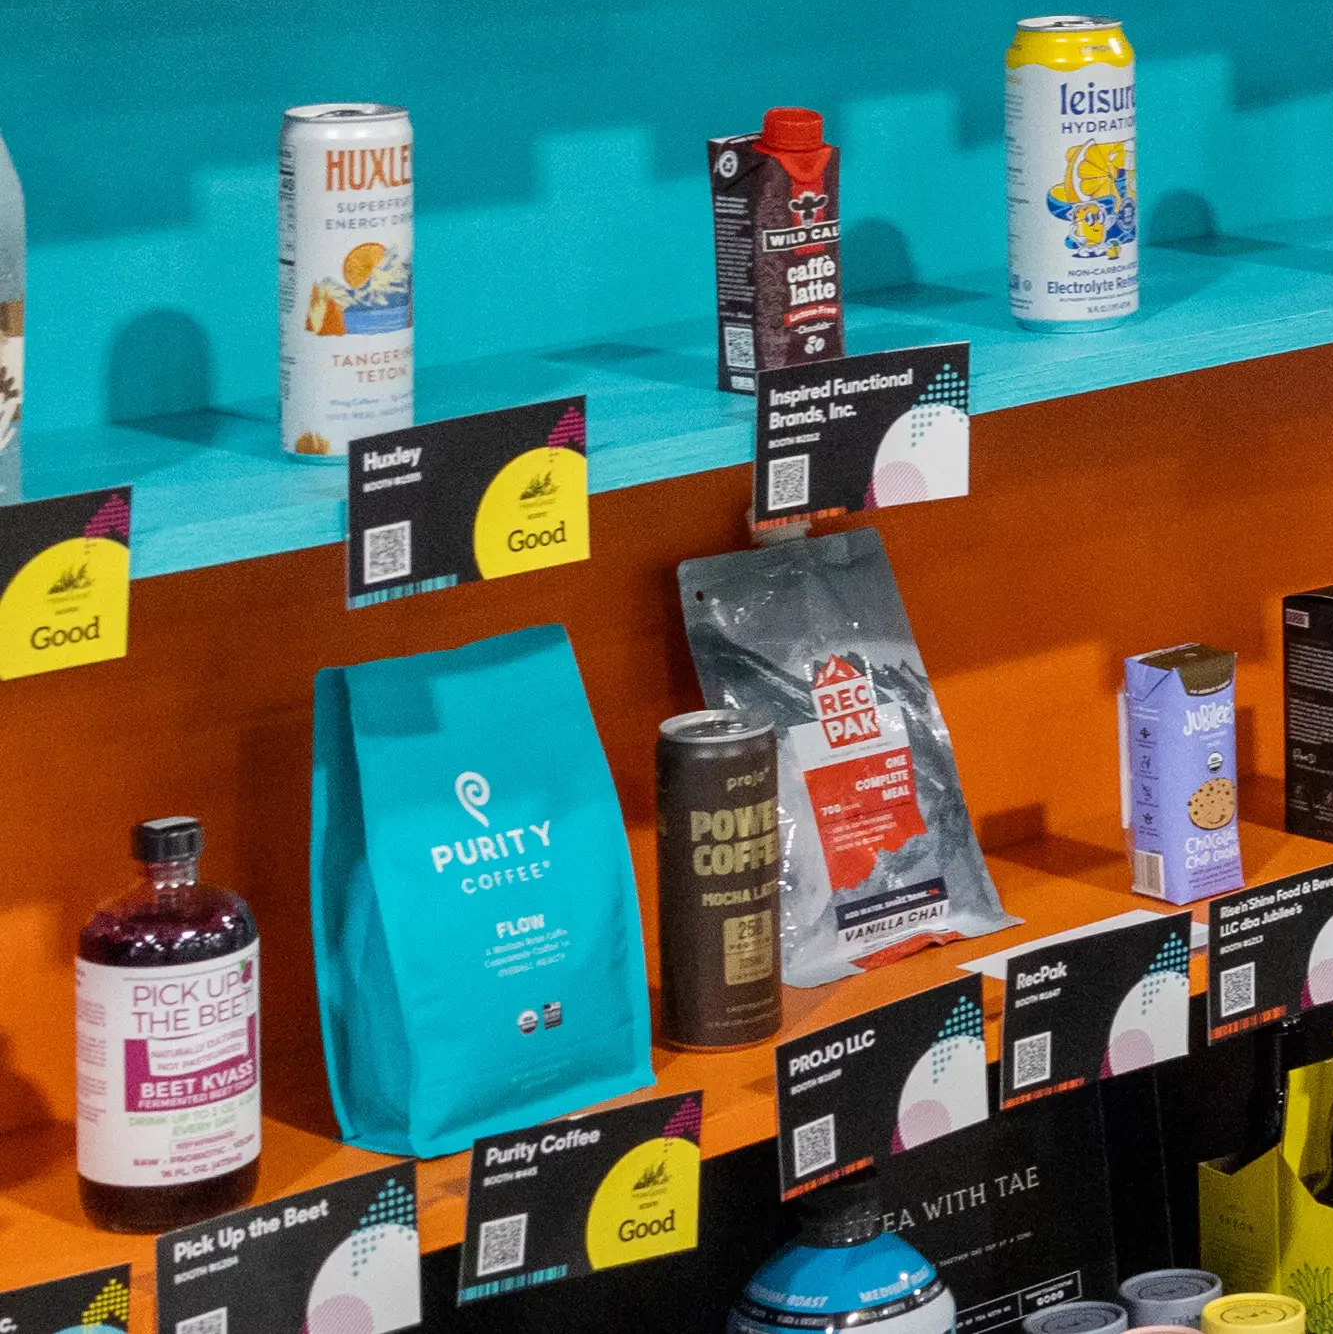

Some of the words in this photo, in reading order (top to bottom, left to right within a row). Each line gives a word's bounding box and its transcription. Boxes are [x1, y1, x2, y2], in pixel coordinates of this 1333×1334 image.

[325, 216, 391, 231] ENERGY
[770, 229, 807, 247] WILD
[787, 254, 837, 284] caffè
[790, 280, 837, 306] latte
[1047, 279, 1114, 296] Electrolyte
[769, 383, 833, 409] Inspired
[834, 369, 913, 399] Functional
[769, 406, 826, 431] Brands,
[829, 402, 857, 421] Inc.
[363, 445, 422, 473] Huxley
[507, 521, 567, 553] Good
[29, 616, 100, 650] Good
[819, 683, 872, 716] REC
[826, 713, 880, 745] PAK
[885, 755, 908, 769] ONE
[855, 769, 910, 792] COMPLETE
[881, 786, 910, 801] MEAL
[430, 820, 554, 874] PURITY
[460, 863, 547, 895] COFFEE
[1276, 884, 1300, 905] Food
[1302, 882, 1311, 896] &
[702, 889, 750, 907] MOCHA
[495, 913, 545, 939] FLOW
[844, 916, 905, 943] VANILLA
[908, 904, 944, 923] CHAI
[1219, 923, 1240, 938] LLC
[1241, 918, 1260, 933] dba
[1261, 904, 1303, 926] Jubilee's
[133, 980, 200, 1007] PICK
[206, 971, 242, 998] UP
[1016, 961, 1067, 990] RecPak
[132, 1009, 190, 1034] THE
[788, 1040, 845, 1077] PROJO
[846, 1029, 877, 1056] LLC
[140, 1078, 198, 1099] BEET
[201, 1058, 255, 1091] KVASS
[138, 1093, 208, 1109] FERMENTED
[172, 1121, 213, 1136] EVERY
[486, 1141, 538, 1167] Purity
[540, 1129, 601, 1154] Coffee
[922, 1182, 987, 1222] WITH
[994, 1166, 1041, 1197] TAE
[174, 1234, 215, 1263] Pick
[217, 1223, 247, 1251] Up
[247, 1214, 281, 1240] the
[283, 1199, 329, 1231] Beet
[618, 1209, 676, 1243] Good
[786, 1295, 829, 1309] ROAST
